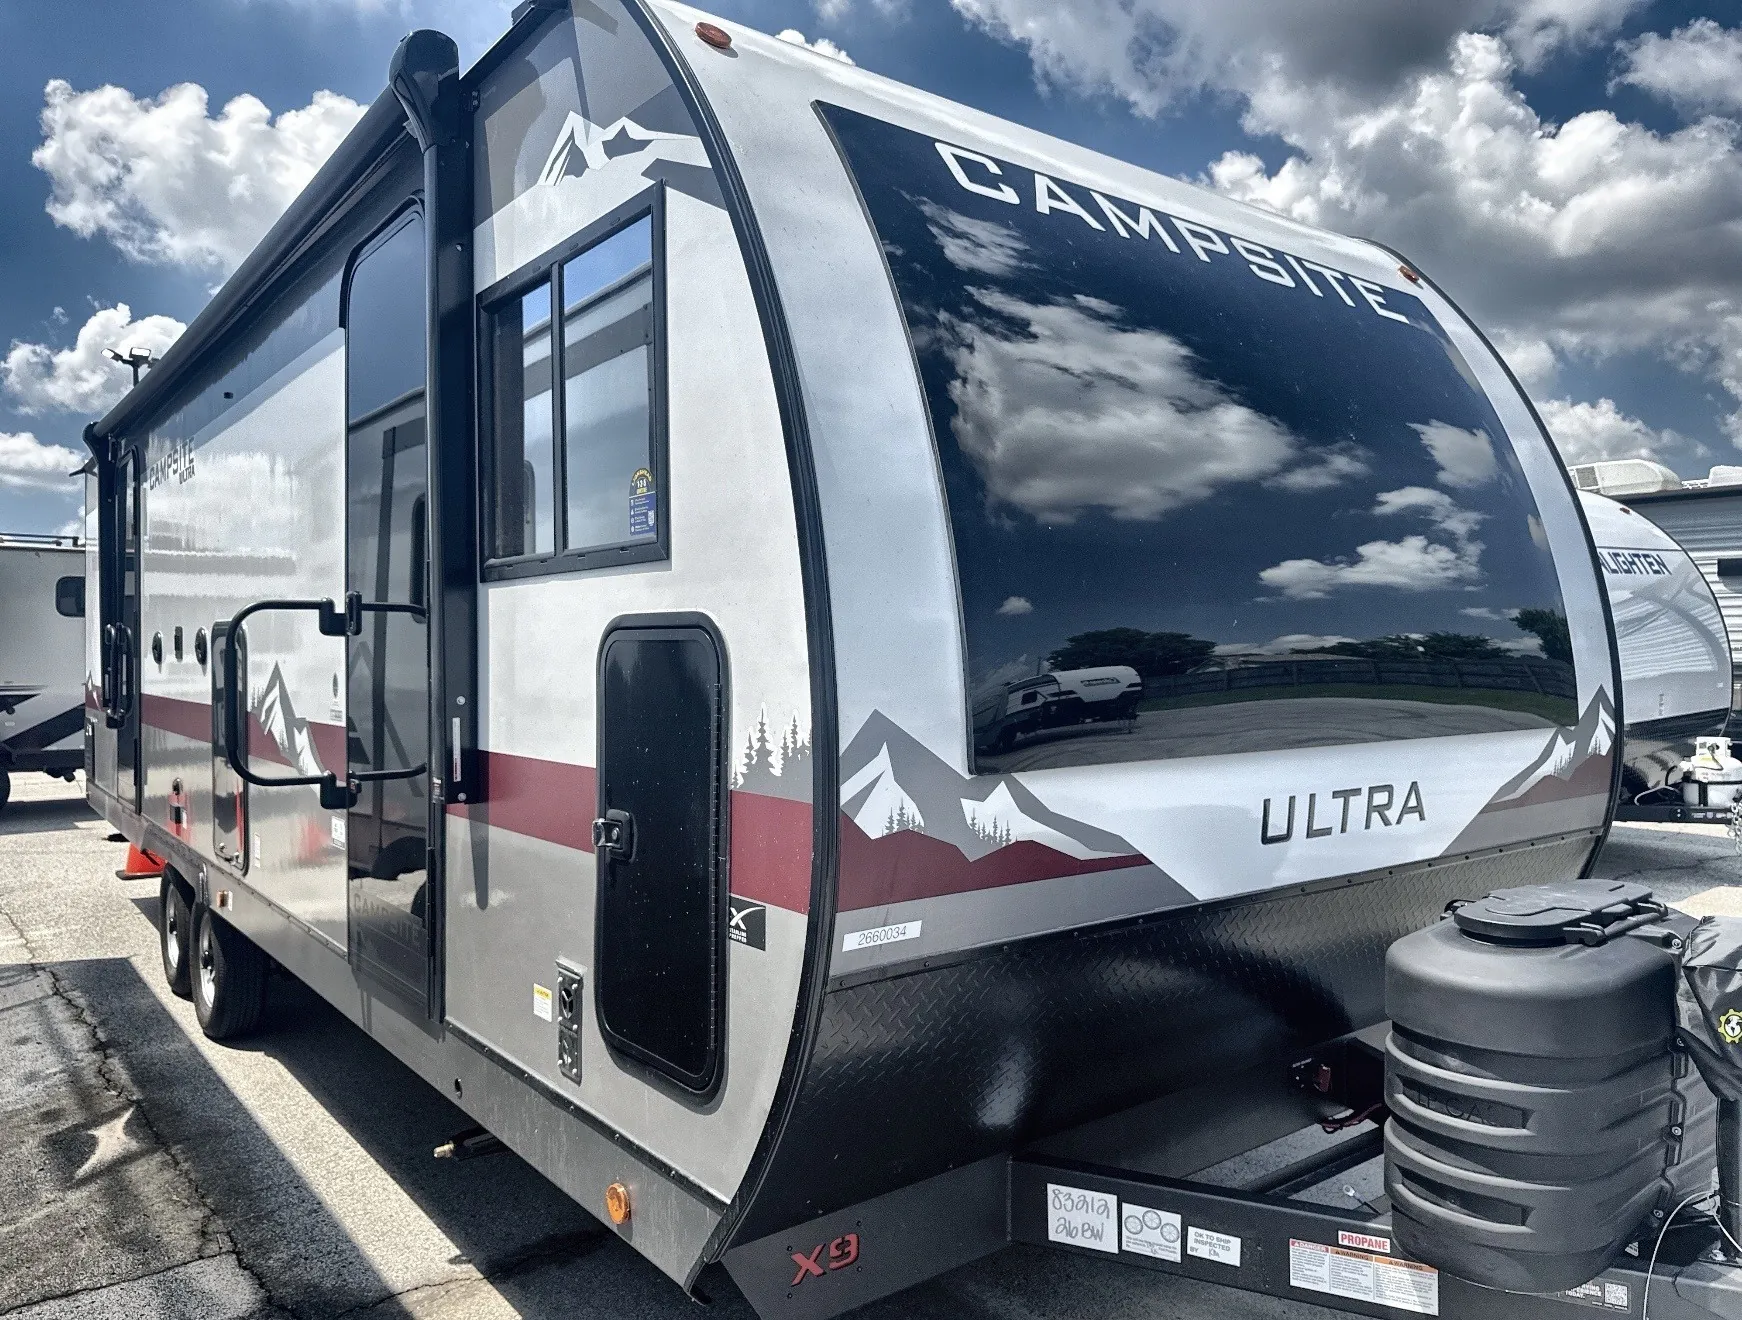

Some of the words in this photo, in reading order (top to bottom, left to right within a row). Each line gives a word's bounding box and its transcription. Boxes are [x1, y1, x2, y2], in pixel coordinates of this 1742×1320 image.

[934, 141, 1410, 325] CAMPSITE
[149, 436, 195, 490] CAMPSITE
[179, 464, 196, 485] ULTRA
[1261, 781, 1426, 846] ULTRA
[857, 925, 908, 947] 2660034
[1052, 1188, 1110, 1219] 83212
[1193, 1238, 1231, 1252] INSPECTED
[1194, 1231, 1204, 1239] OK
[1205, 1233, 1215, 1241] TO
[1216, 1236, 1231, 1245] SHIP
[1340, 1233, 1388, 1250] PROPANE
[790, 1232, 860, 1288] X9
[1341, 1250, 1369, 1261] WARNING
[1394, 1260, 1423, 1271] WARNING
